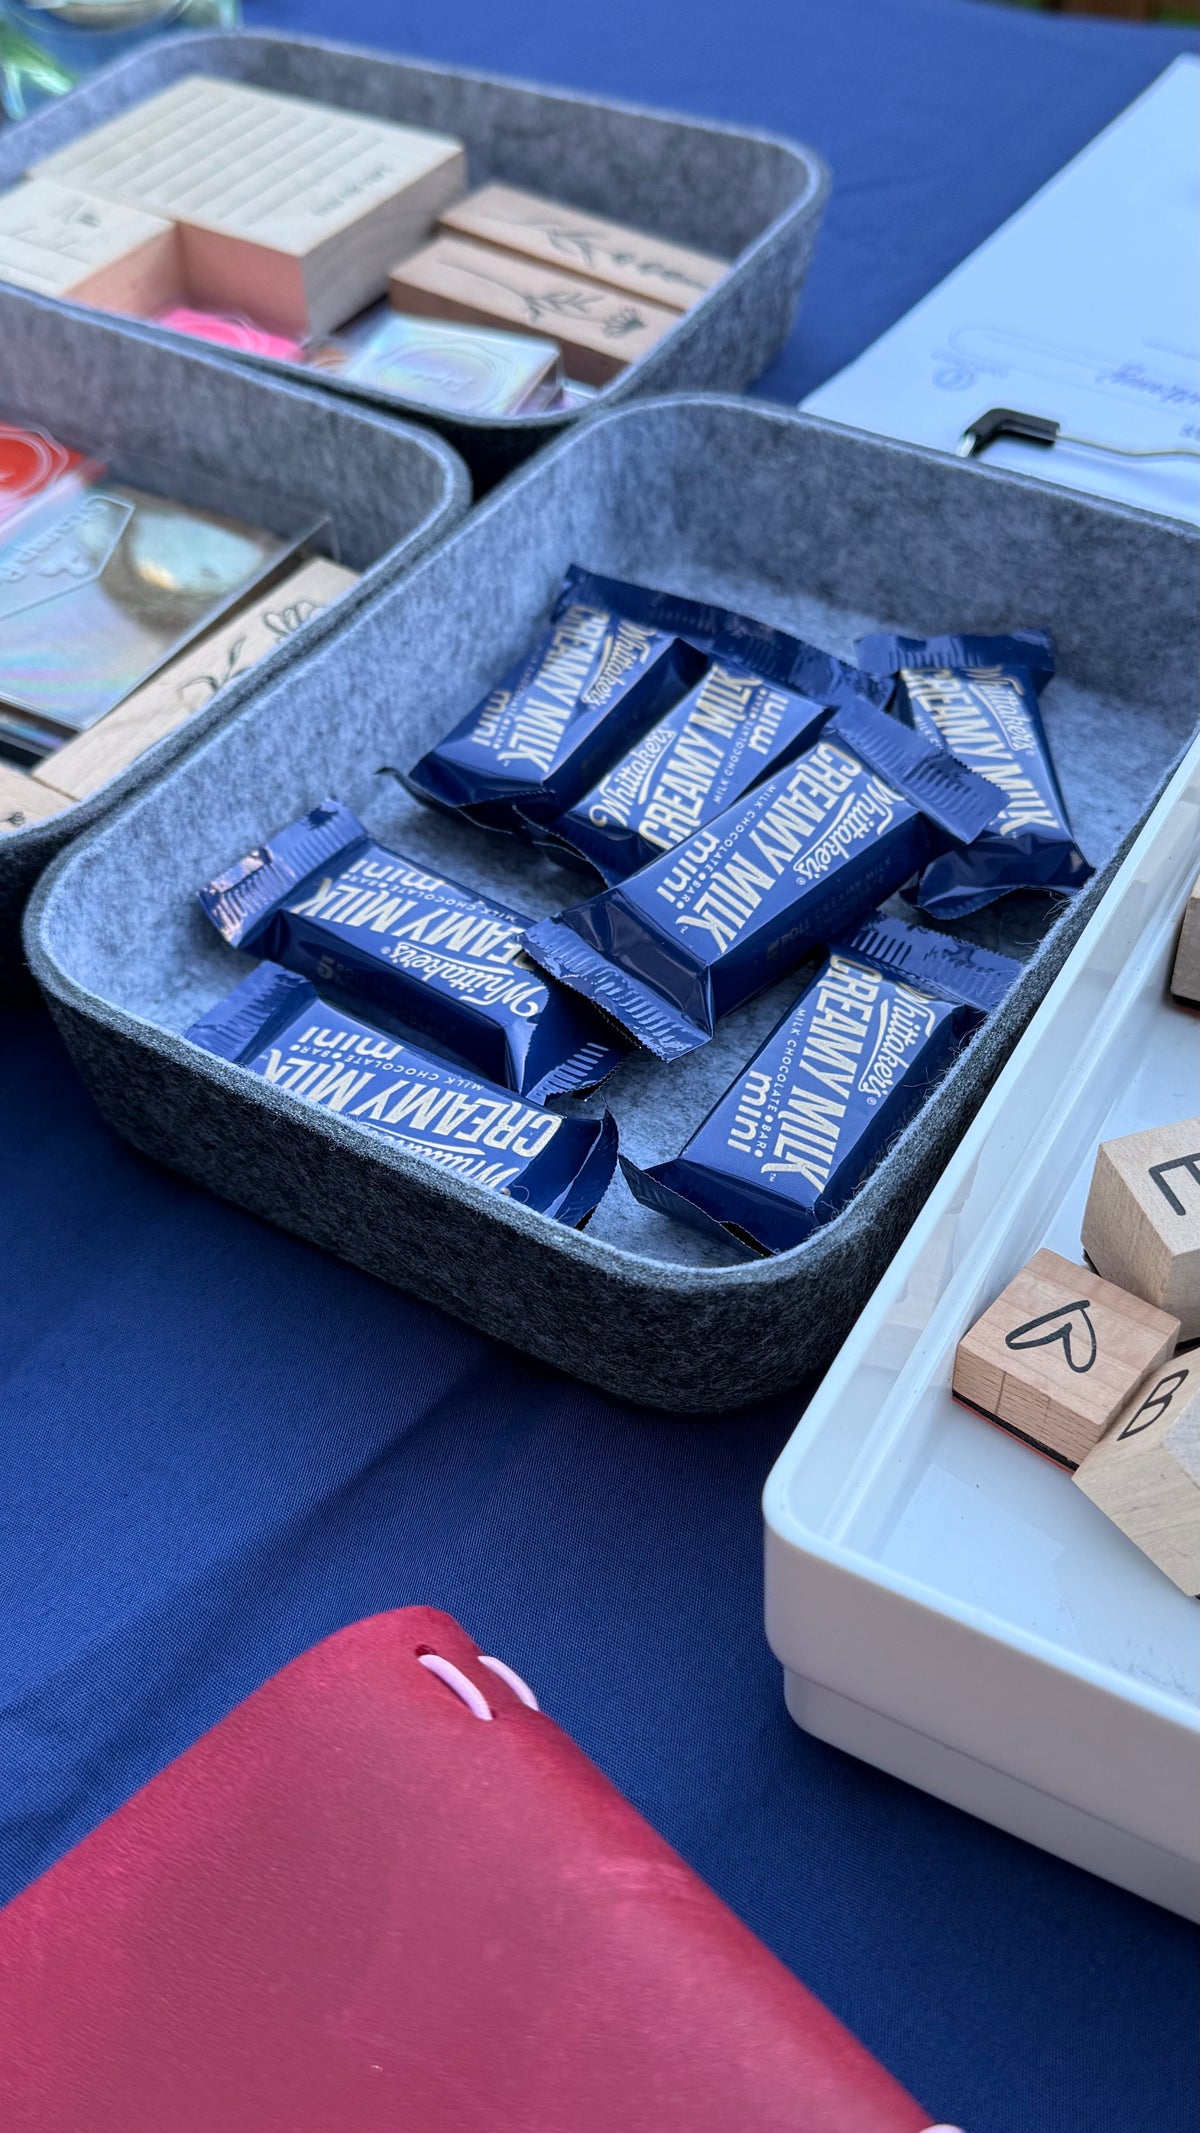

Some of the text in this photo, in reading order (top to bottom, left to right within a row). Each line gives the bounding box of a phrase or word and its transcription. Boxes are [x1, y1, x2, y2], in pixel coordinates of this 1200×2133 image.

[472, 690, 511, 746] mini
[497, 604, 610, 773] CREAMY MILK
[748, 692, 789, 755] mini
[900, 667, 1014, 760] CREAMY
[589, 729, 676, 827] Whittaker's
[639, 663, 763, 850] CREAMY MILK
[713, 778, 731, 804] MILK
[657, 830, 720, 904] mini
[676, 743, 861, 953] CREAMY MILK
[684, 784, 776, 902] MILK CHOCOLATE BAR
[793, 775, 906, 883] Whittaker's
[351, 859, 444, 892] mini
[293, 878, 536, 971] EAMY MILK
[391, 942, 547, 1017] Whittaker's
[298, 1026, 401, 1060] mini
[301, 1044, 484, 1092] MILK CHOCOLATE BAR
[758, 1009, 806, 1149] MILK CHOCOLATE BAR
[761, 955, 882, 1193] CREAMY MILK
[858, 981, 936, 1099] Whittaker's
[349, 1081, 562, 1159] CREAMY
[728, 1071, 773, 1153] mini
[1116, 1369, 1189, 1441] B
